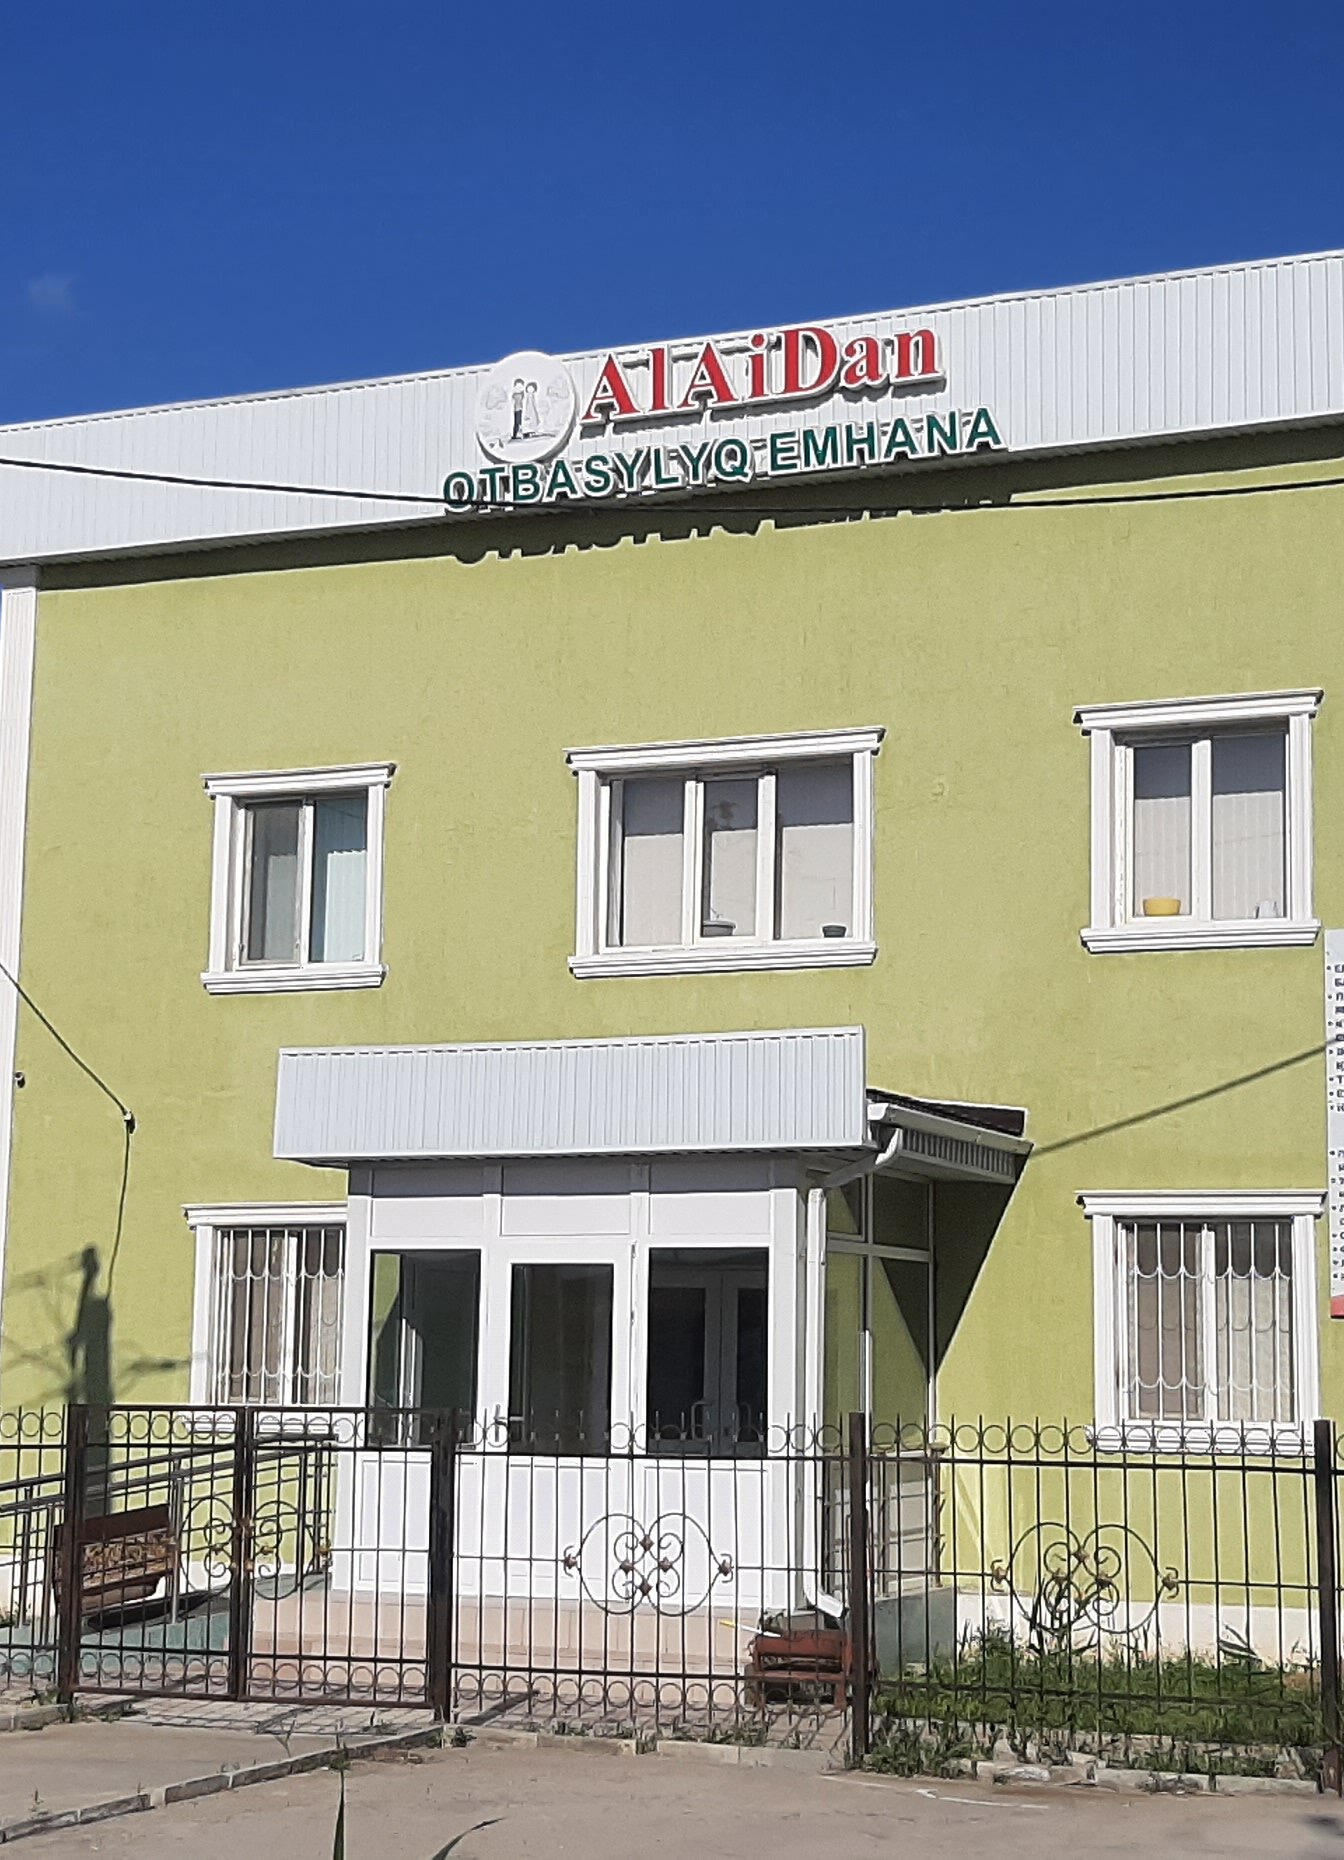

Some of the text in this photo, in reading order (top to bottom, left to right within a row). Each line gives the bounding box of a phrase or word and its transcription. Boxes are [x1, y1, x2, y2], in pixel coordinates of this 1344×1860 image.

[582, 327, 938, 420] AlAiDan
[443, 408, 1002, 511] OTBASYLYQ EMHANA
